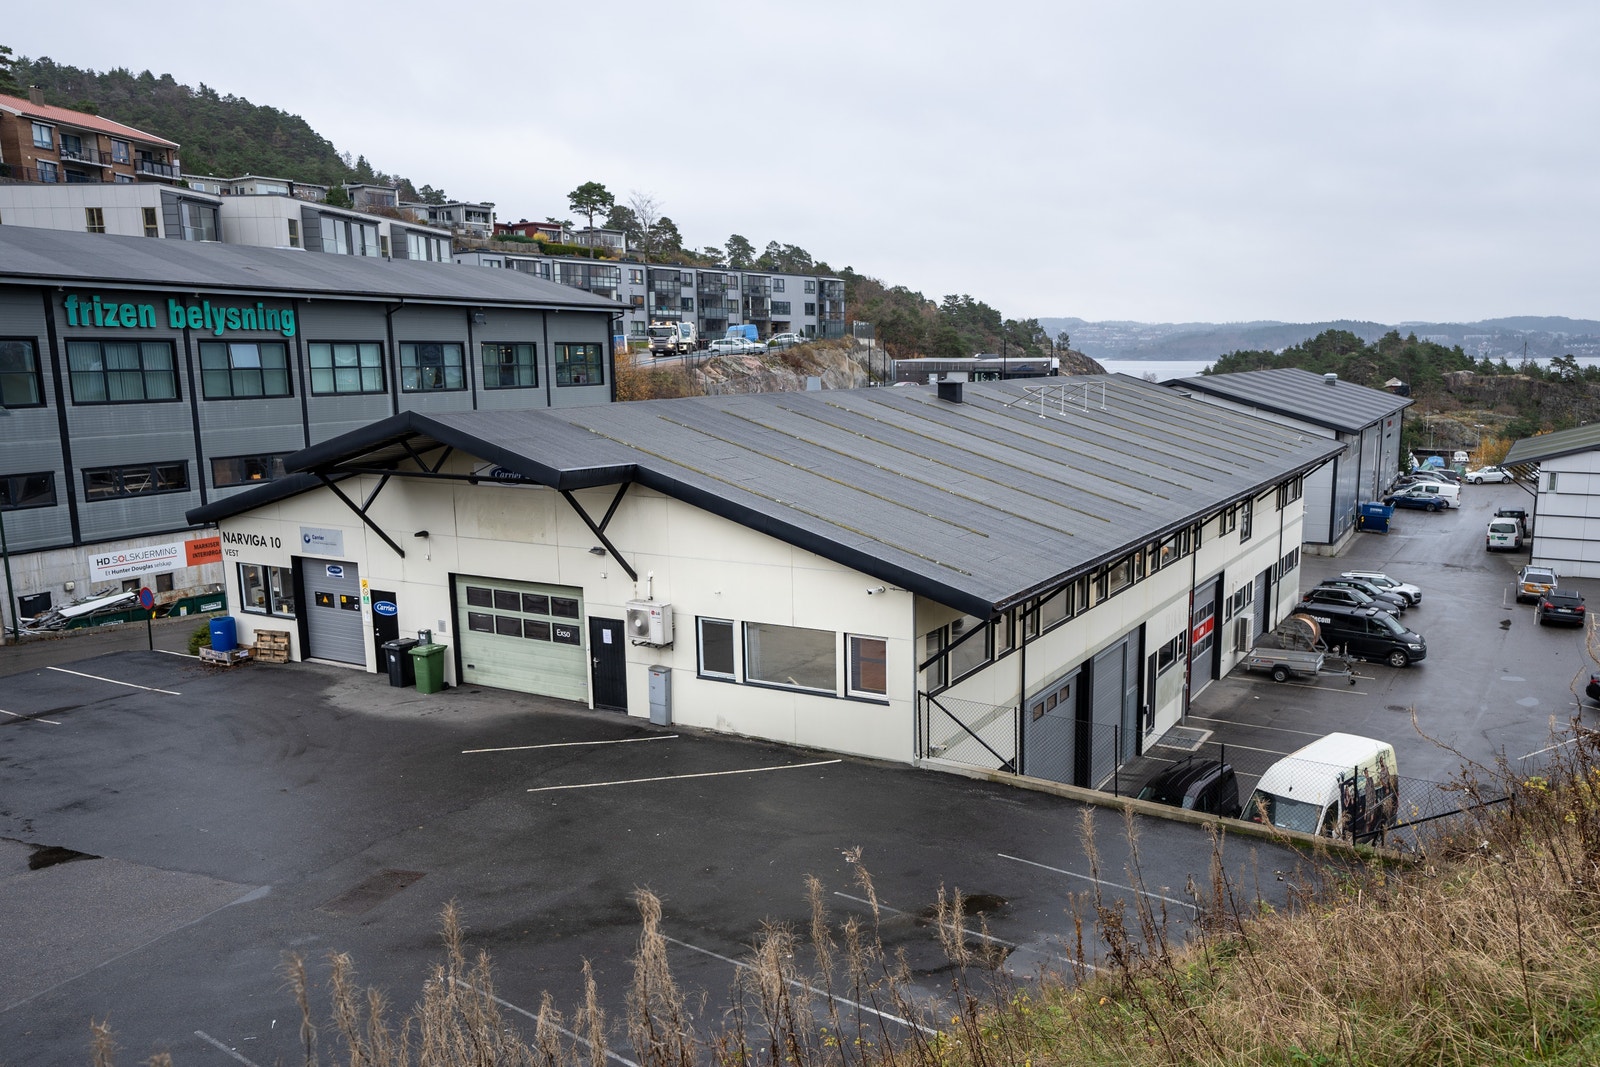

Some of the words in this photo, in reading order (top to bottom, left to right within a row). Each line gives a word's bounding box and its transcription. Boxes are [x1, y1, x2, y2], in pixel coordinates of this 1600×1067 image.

[65, 295, 156, 327] frizen
[168, 298, 295, 336] belysning
[223, 531, 267, 548] NARVIGA
[270, 536, 281, 549] 10
[96, 557, 110, 566] HD
[112, 547, 177, 564] SOLSKJERMING
[224, 548, 239, 557] VEST
[111, 567, 131, 576] Hunter
[131, 564, 154, 573] Douglas
[154, 560, 172, 569] selskap
[376, 603, 396, 612] Carrier
